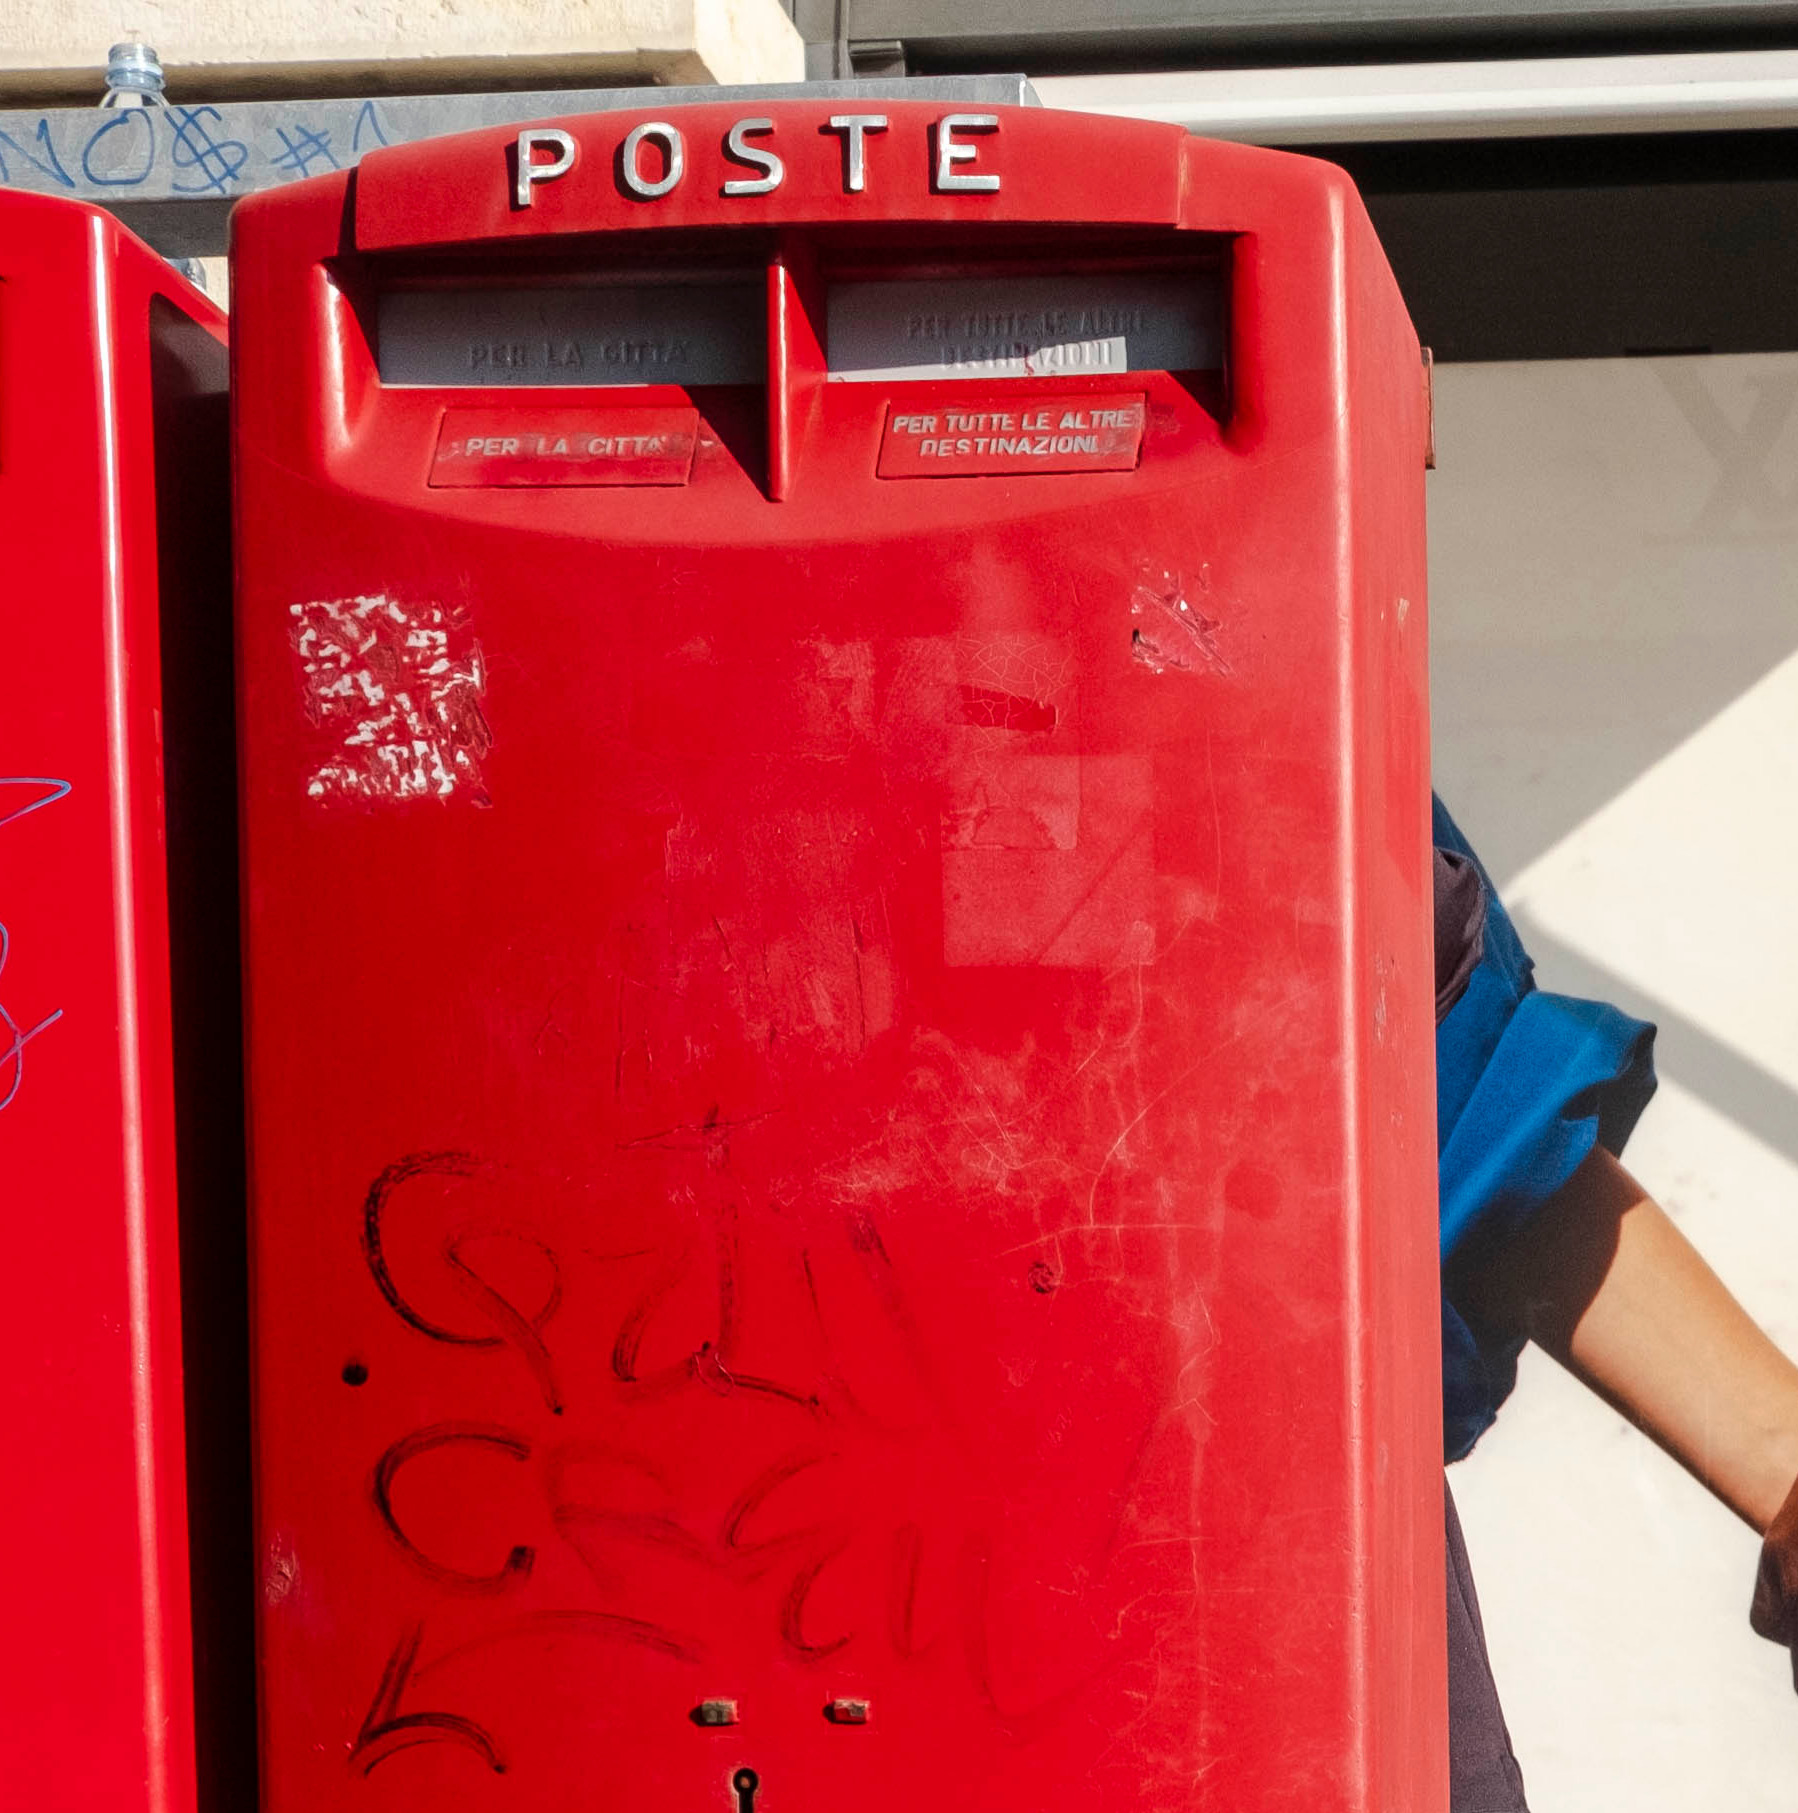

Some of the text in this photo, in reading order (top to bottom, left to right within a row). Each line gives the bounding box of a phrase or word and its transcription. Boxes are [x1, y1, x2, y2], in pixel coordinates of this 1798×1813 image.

[517, 113, 1001, 207] POSTE
[468, 343, 528, 369] PER
[543, 341, 584, 368] LA
[893, 409, 1136, 434] PER TUTTE LE ALTRE
[465, 436, 520, 457] PER
[536, 437, 569, 455] LA
[919, 434, 1100, 458] DESTINAZIONI
